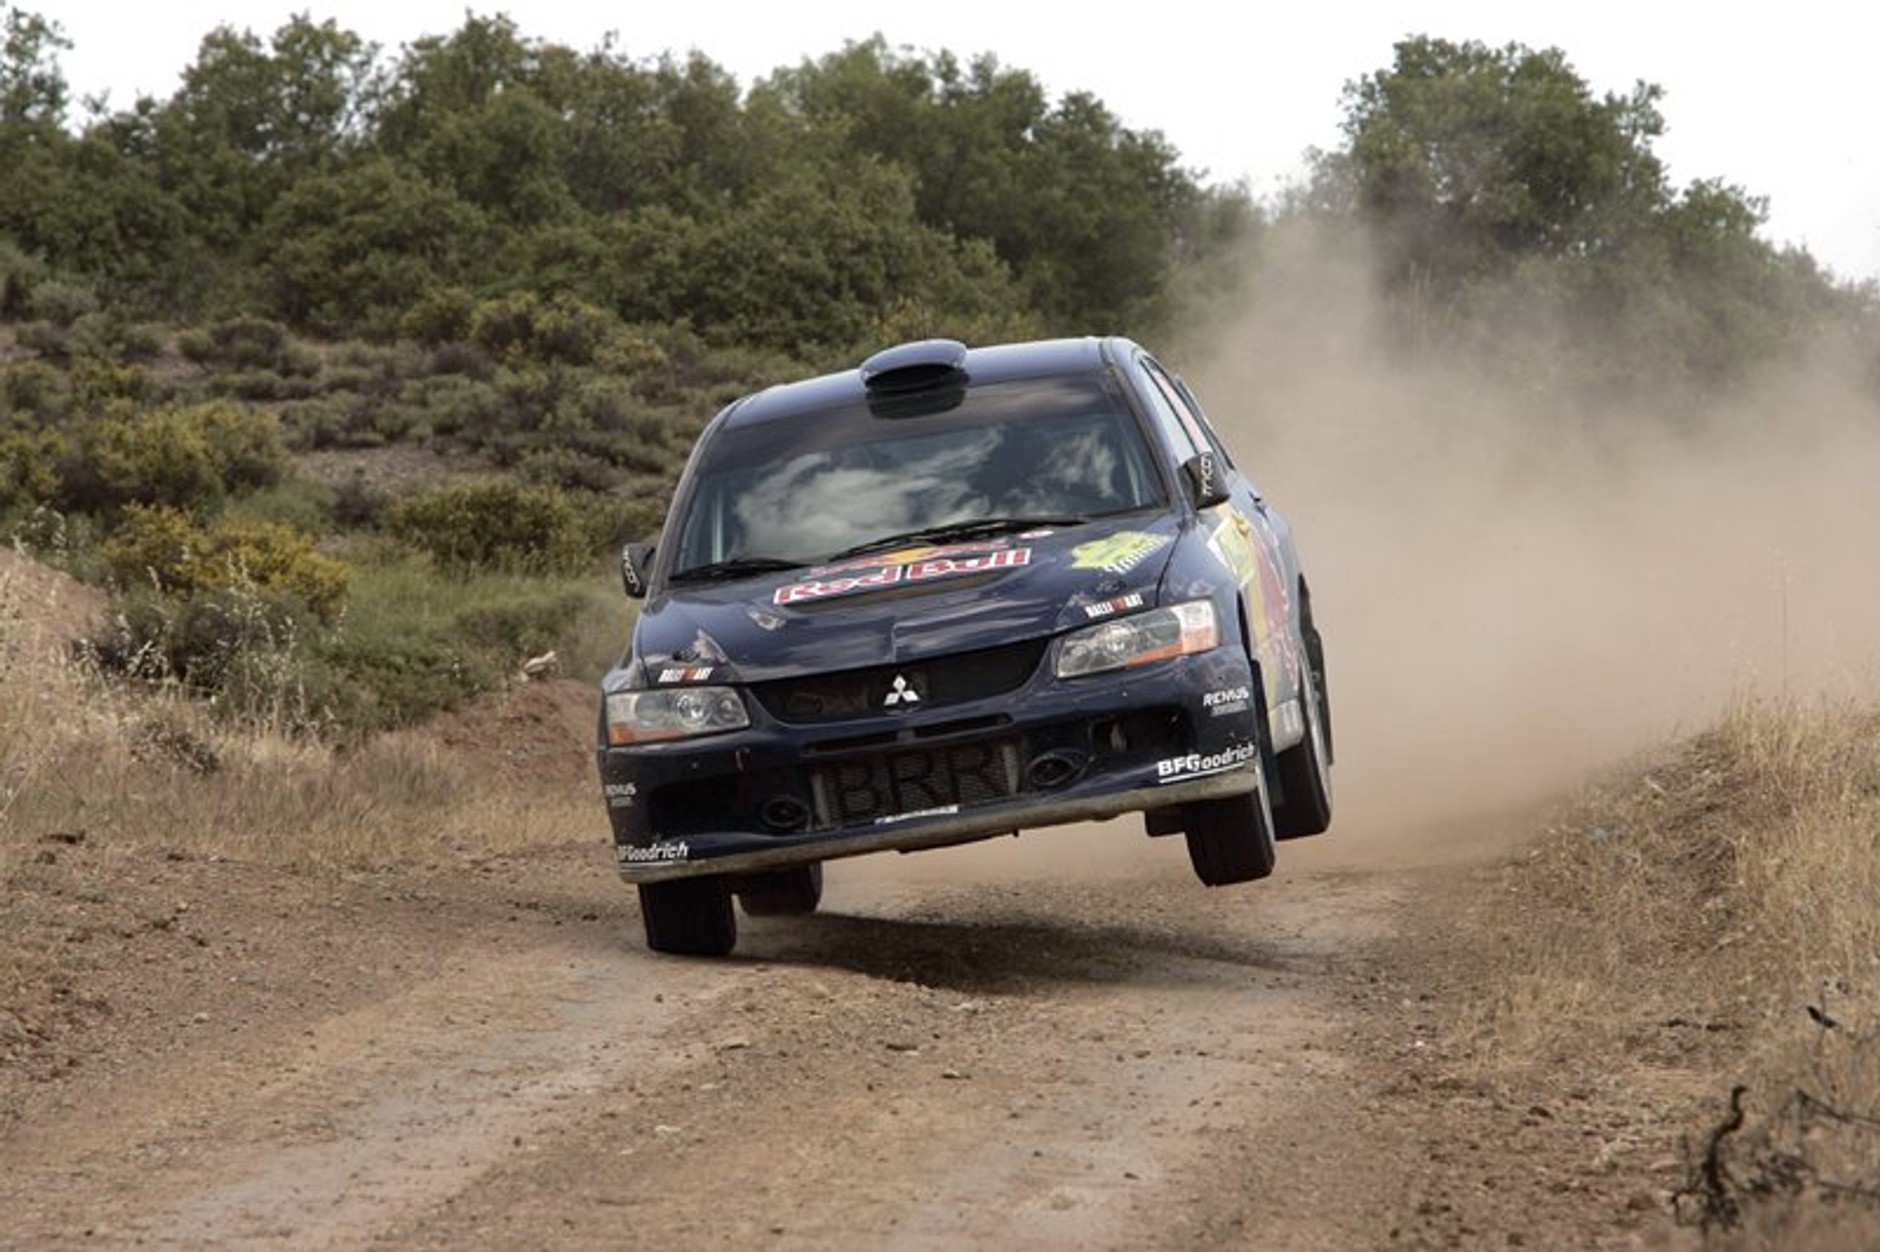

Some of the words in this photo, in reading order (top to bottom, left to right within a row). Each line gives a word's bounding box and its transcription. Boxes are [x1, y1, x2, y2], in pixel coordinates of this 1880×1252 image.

[773, 566, 901, 605] Red
[907, 548, 1031, 579] Bull
[1158, 742, 1254, 777] BFGoodrich
